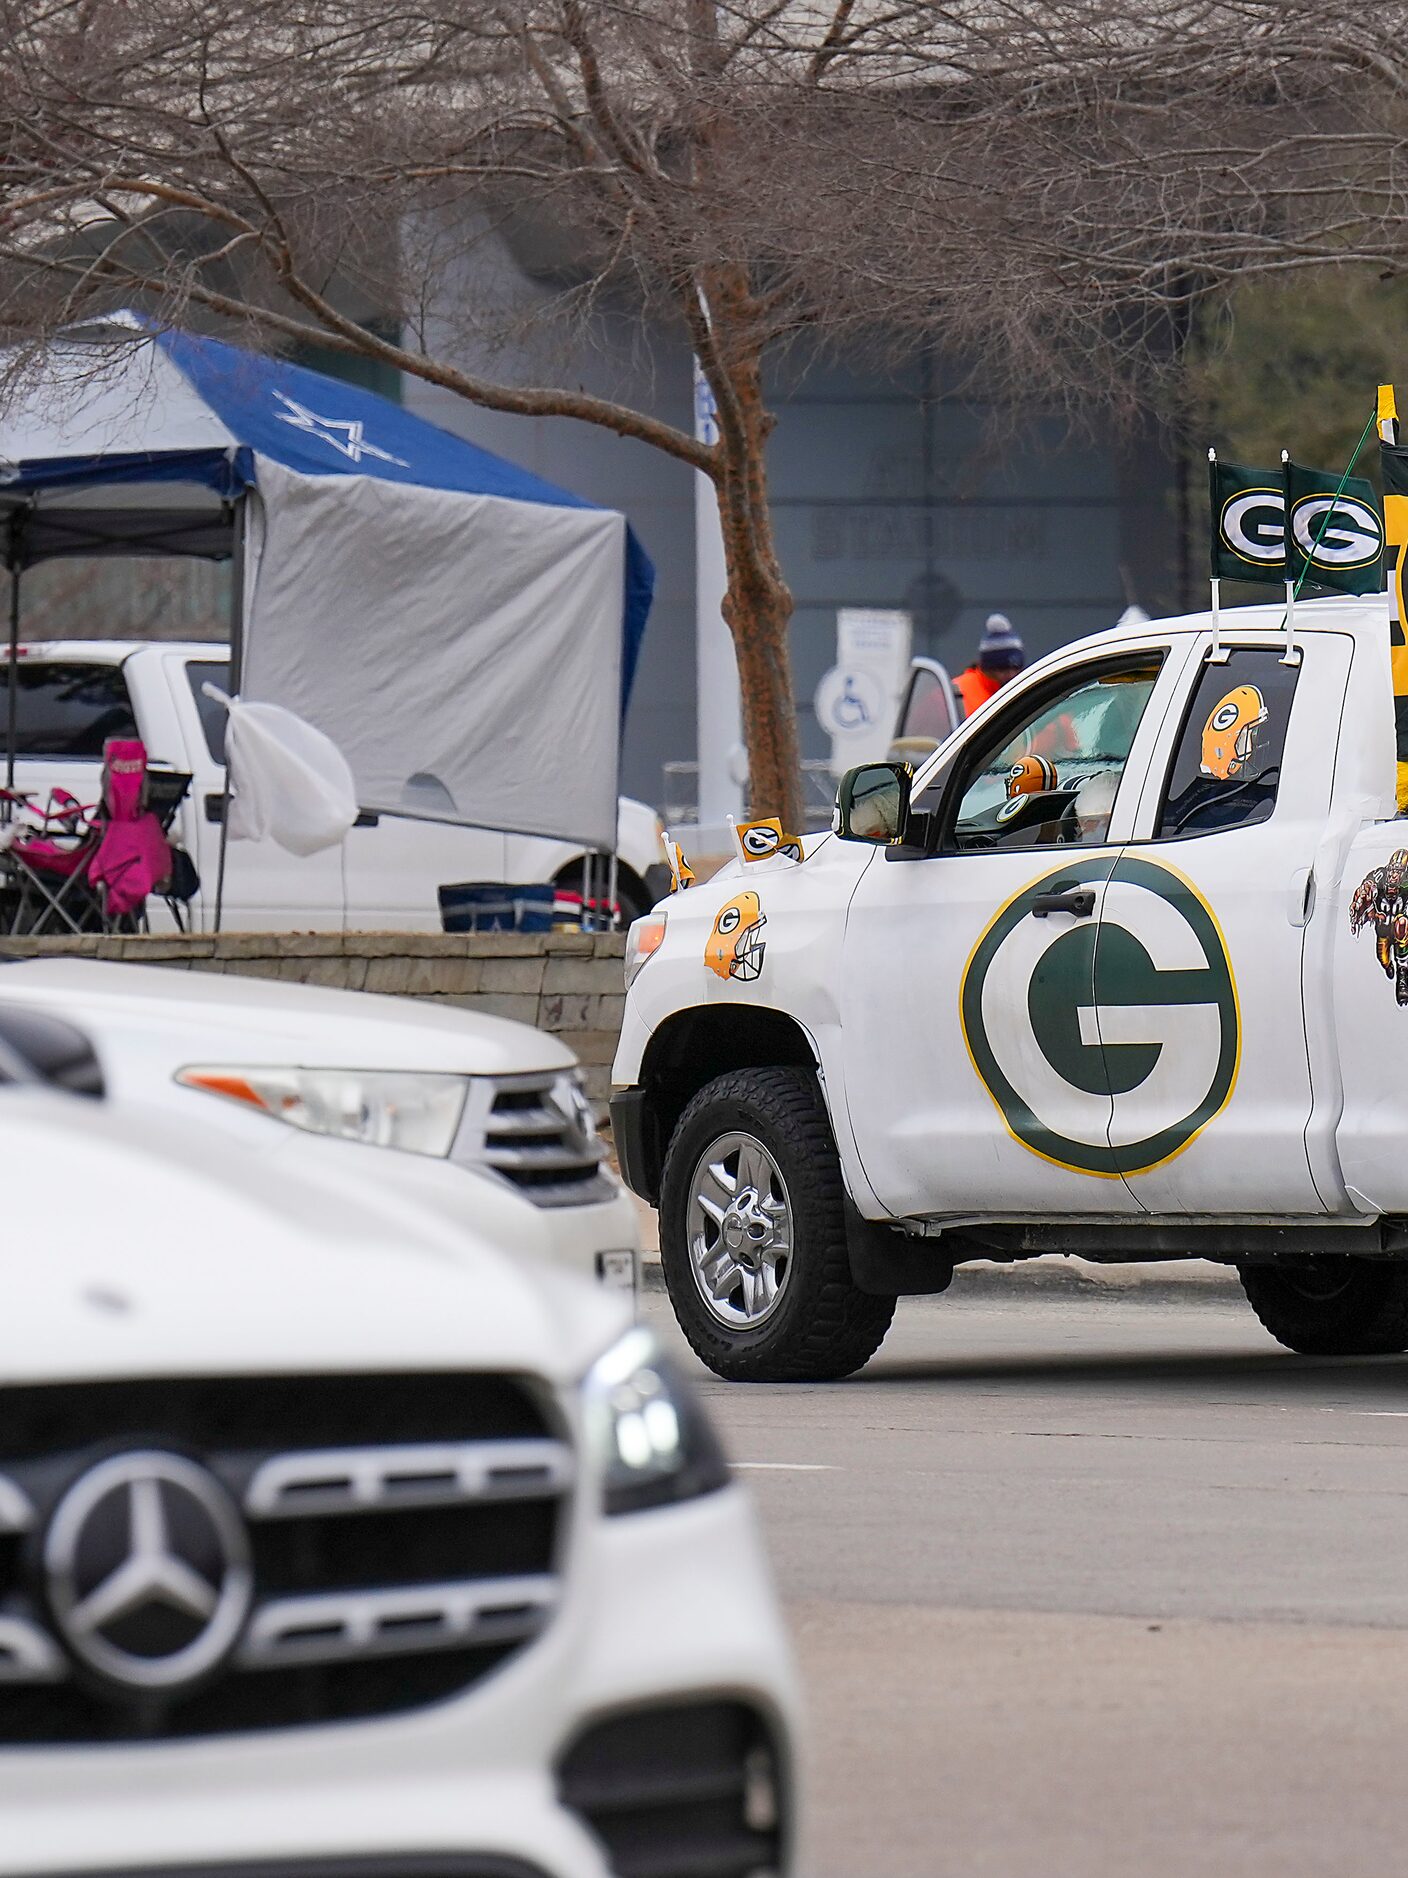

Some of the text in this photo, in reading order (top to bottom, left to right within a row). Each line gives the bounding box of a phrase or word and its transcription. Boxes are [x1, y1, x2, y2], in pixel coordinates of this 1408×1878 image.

[1292, 499, 1382, 563] G
[1212, 704, 1239, 731] G
[718, 907, 740, 934] G
[980, 880, 1223, 1149] G
